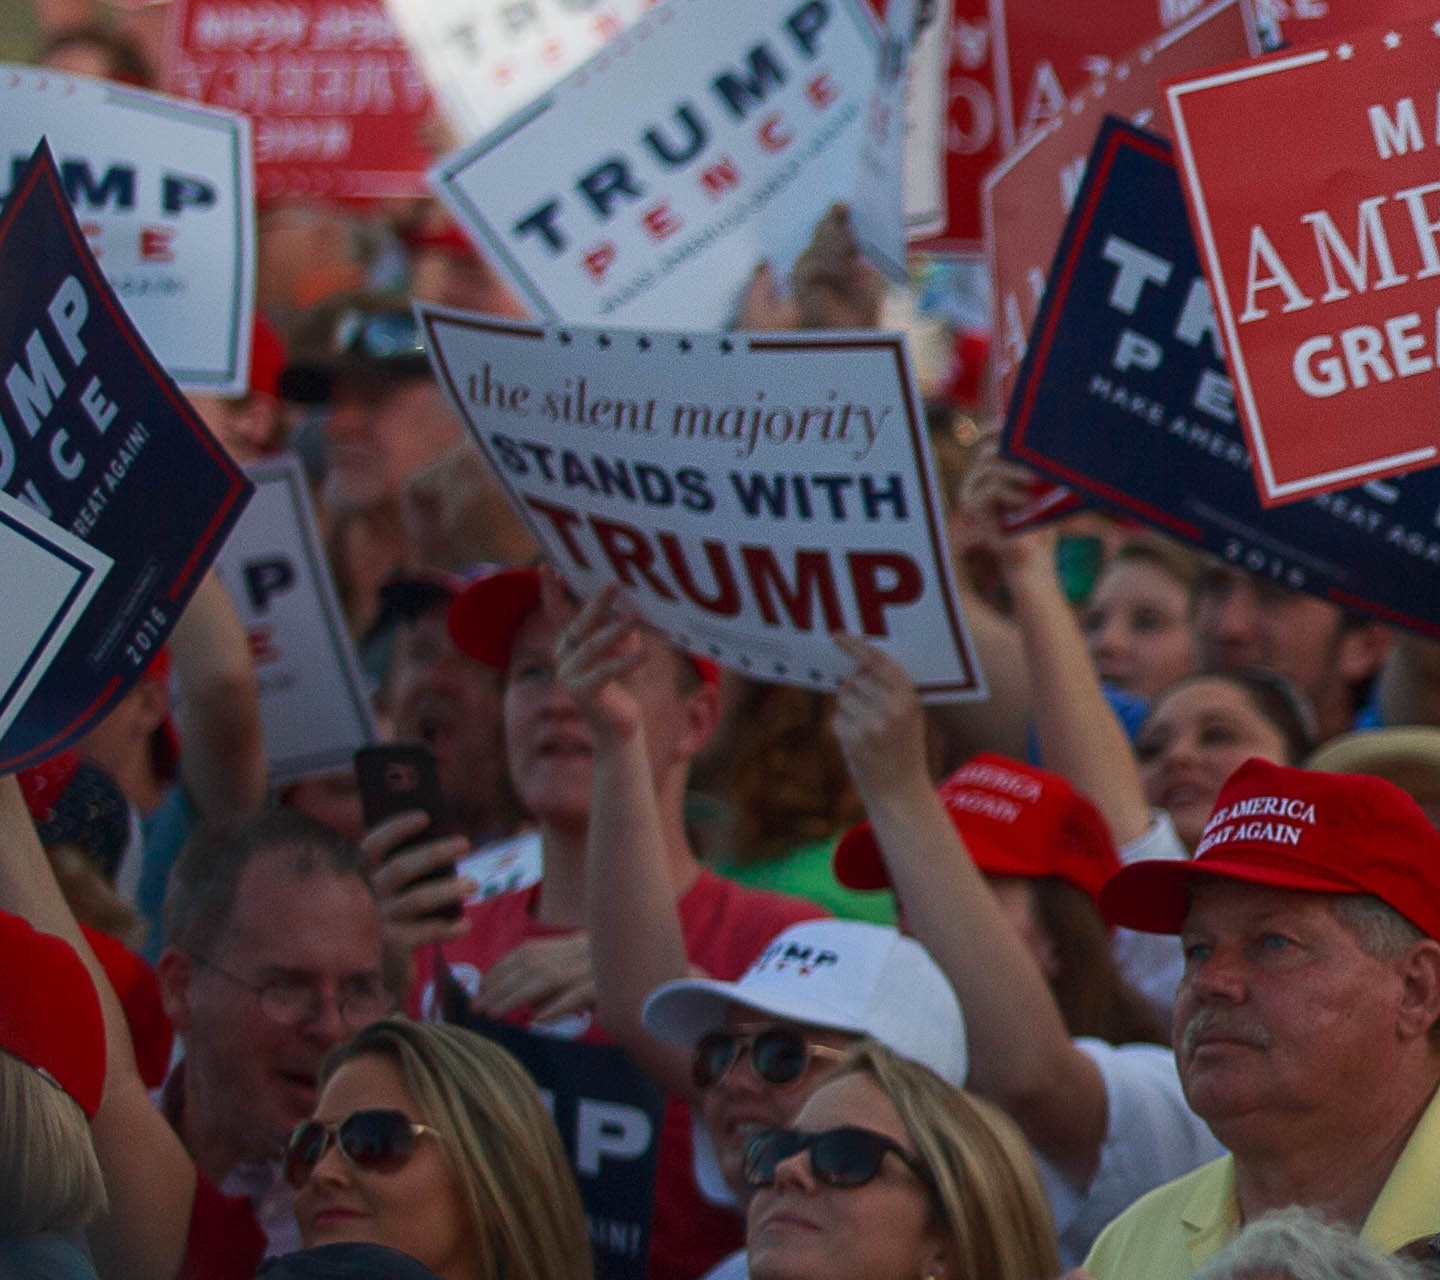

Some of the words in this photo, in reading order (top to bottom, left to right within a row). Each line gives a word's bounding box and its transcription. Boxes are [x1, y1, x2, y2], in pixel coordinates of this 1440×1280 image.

[581, 70, 839, 286] PENCE
[467, 362, 530, 413] the
[541, 377, 657, 440] silent
[671, 390, 894, 460] majority
[1089, 374, 1166, 423] MAKE
[490, 433, 717, 515] STANDS
[730, 469, 910, 521] WITH
[523, 493, 926, 638] TRUMP
[126, 605, 168, 666] 2016
[1230, 795, 1316, 827] AMERICA
[1233, 819, 1301, 847] AGAIN
